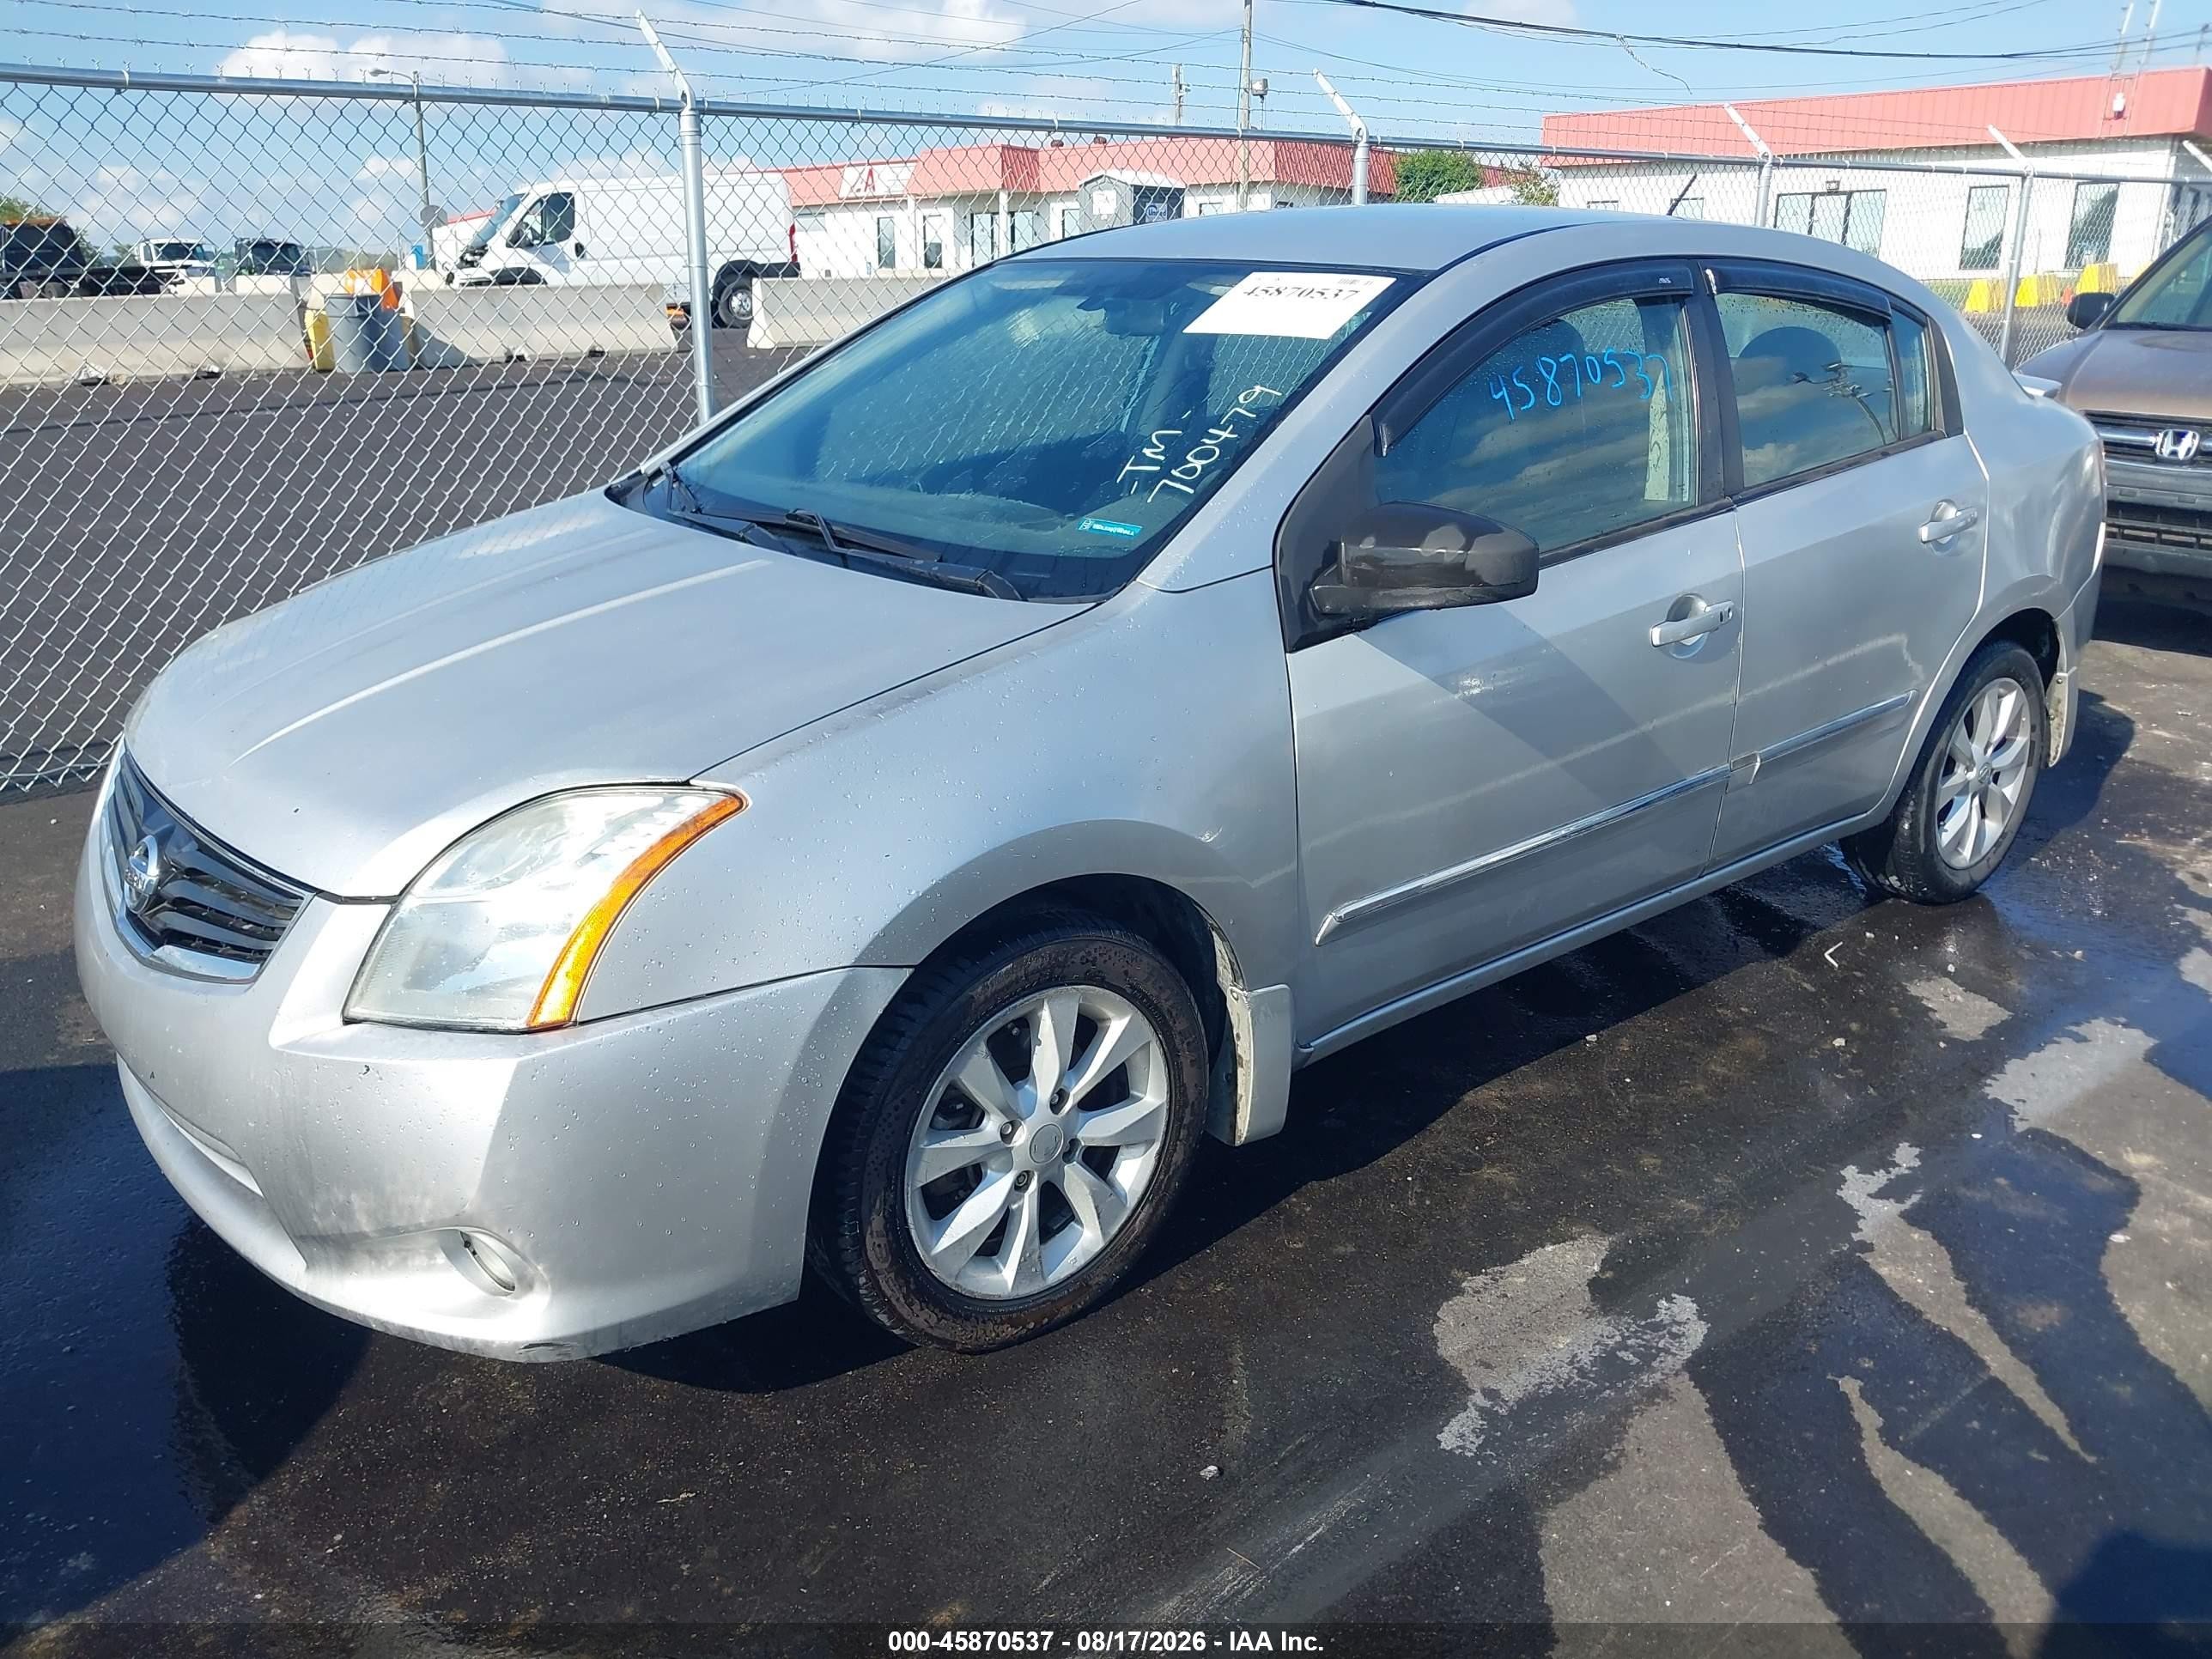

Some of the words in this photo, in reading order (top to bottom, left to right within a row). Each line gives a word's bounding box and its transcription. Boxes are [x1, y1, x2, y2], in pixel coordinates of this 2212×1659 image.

[1243, 285, 1361, 301] 45870537
[1489, 347, 1673, 420] 45870537
[1146, 385, 1283, 503] 700479
